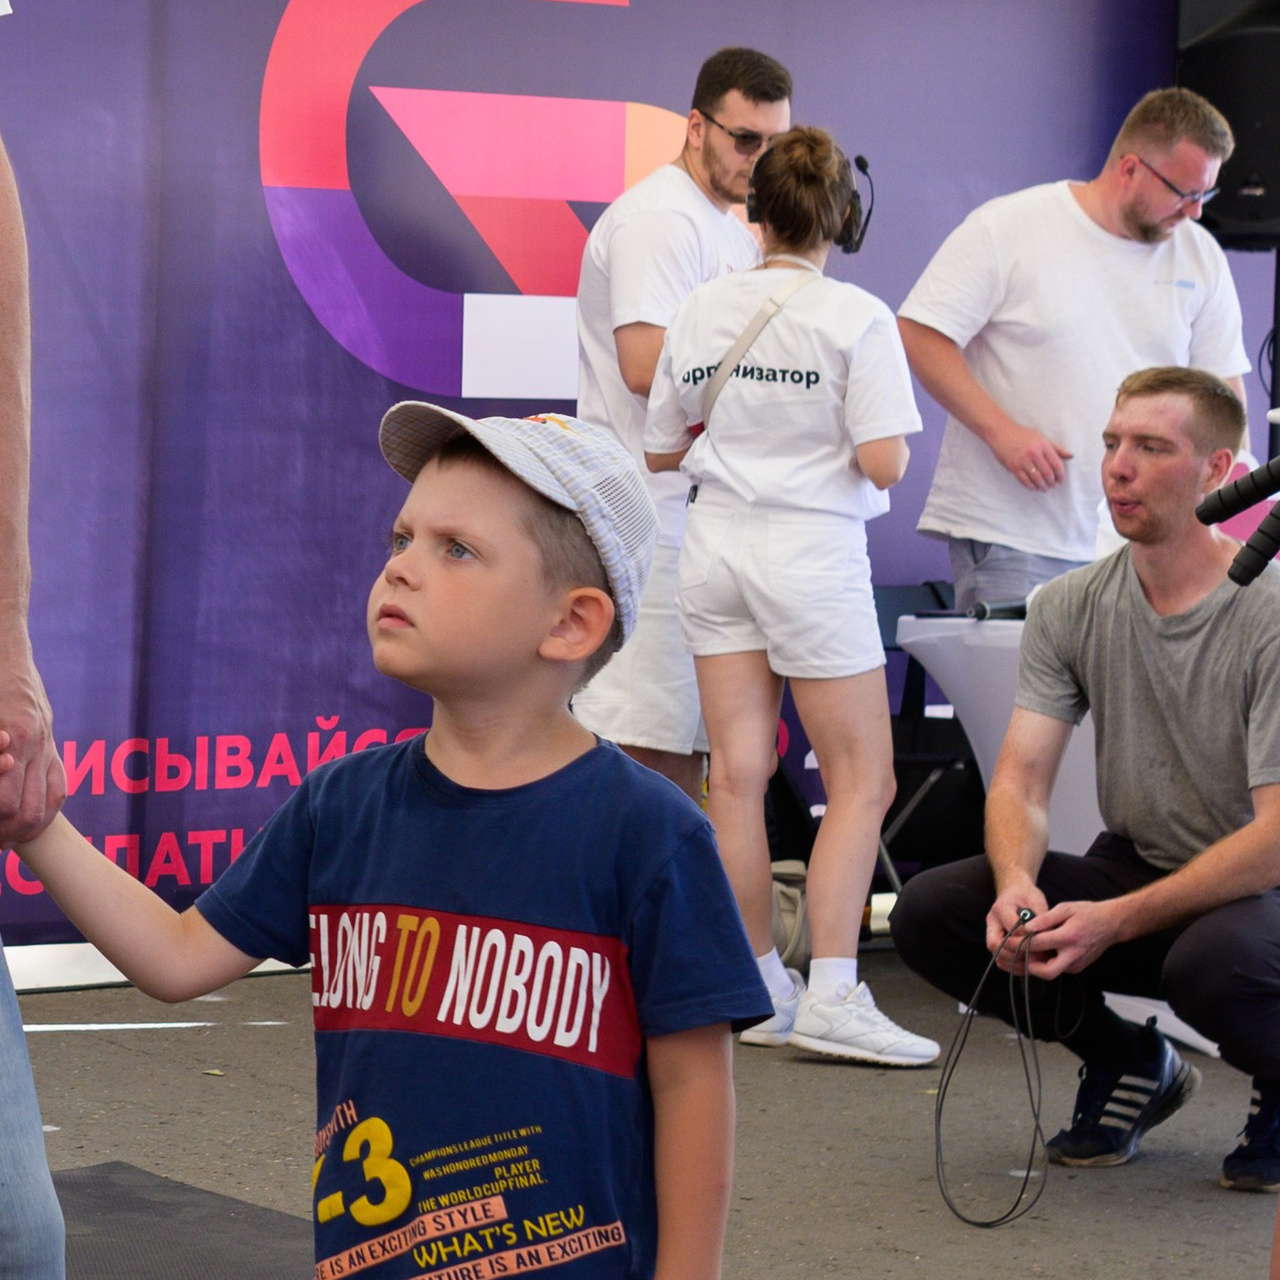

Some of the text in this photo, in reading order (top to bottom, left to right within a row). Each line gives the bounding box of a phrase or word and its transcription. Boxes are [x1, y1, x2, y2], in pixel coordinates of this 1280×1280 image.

[682, 362, 820, 389] оргнизатор
[54, 716, 431, 796] ИСЫВАЙ
[385, 914, 441, 1017] TO
[436, 924, 611, 1053] NOBODY
[493, 1158, 541, 1180] PLAYER
[329, 1203, 496, 1277] IS AN EXCITING STYLE
[413, 1204, 586, 1269] WHAT'S NEW
[489, 1255, 509, 1276] IS
[515, 1248, 543, 1270] AN
[547, 1225, 623, 1262] EXCITING
